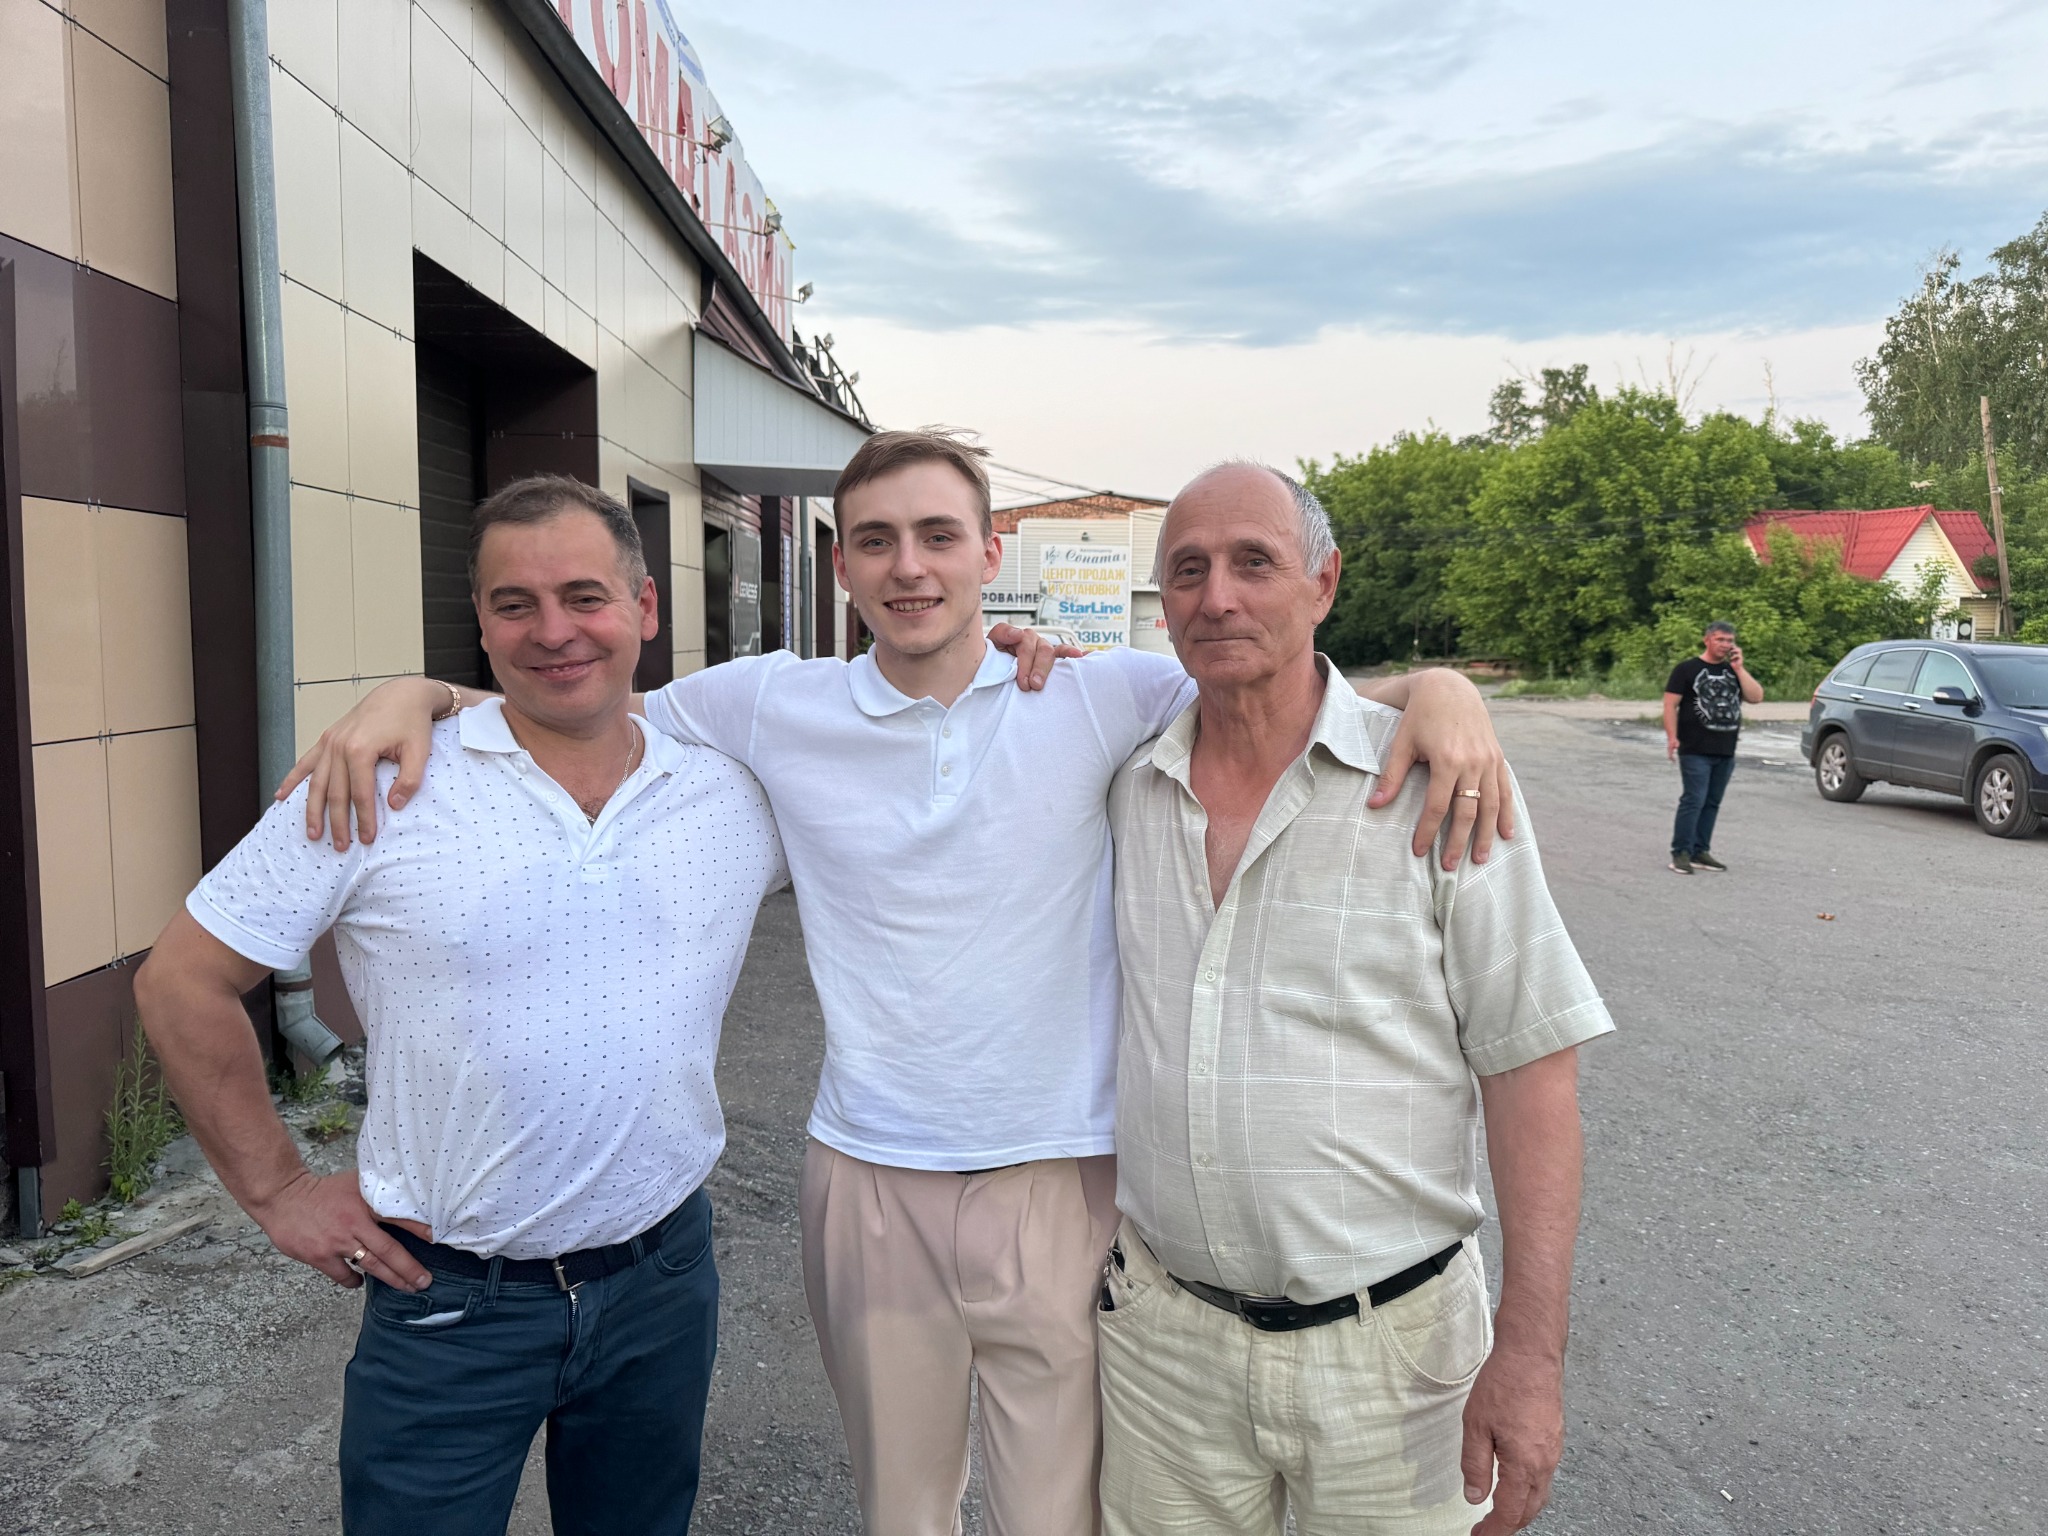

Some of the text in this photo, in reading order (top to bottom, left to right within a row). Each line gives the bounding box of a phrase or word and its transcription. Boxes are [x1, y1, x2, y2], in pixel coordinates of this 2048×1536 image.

[558, 0, 785, 342] ОМАГАЗИН
[1066, 549, 1120, 563] Соната
[1042, 568, 1126, 581] ЦЕНТР ПРОДАЖ
[1048, 583, 1120, 595] И УСТАНОВКИ
[1059, 601, 1123, 614] StarLine
